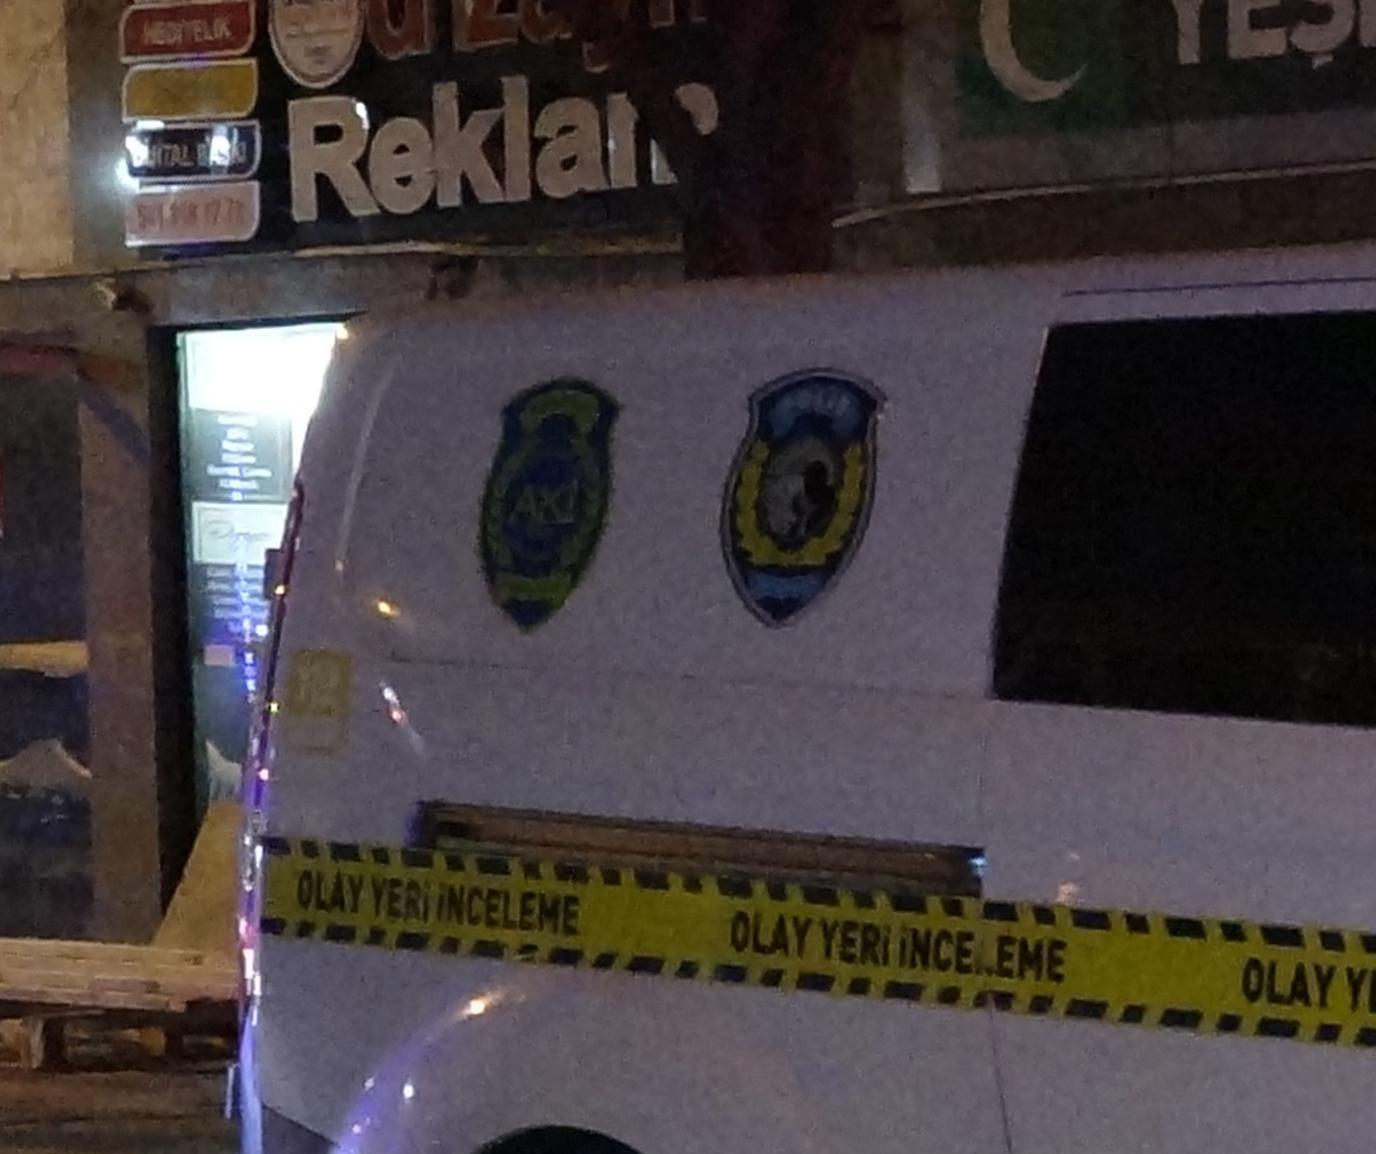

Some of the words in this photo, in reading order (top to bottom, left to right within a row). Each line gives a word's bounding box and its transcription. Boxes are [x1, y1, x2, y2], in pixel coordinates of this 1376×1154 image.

[297, 869, 364, 914] OLAY
[730, 910, 813, 959] OLAY
[900, 926, 1067, 983] İNCEEME
[1242, 957, 1335, 1009] OLAY
